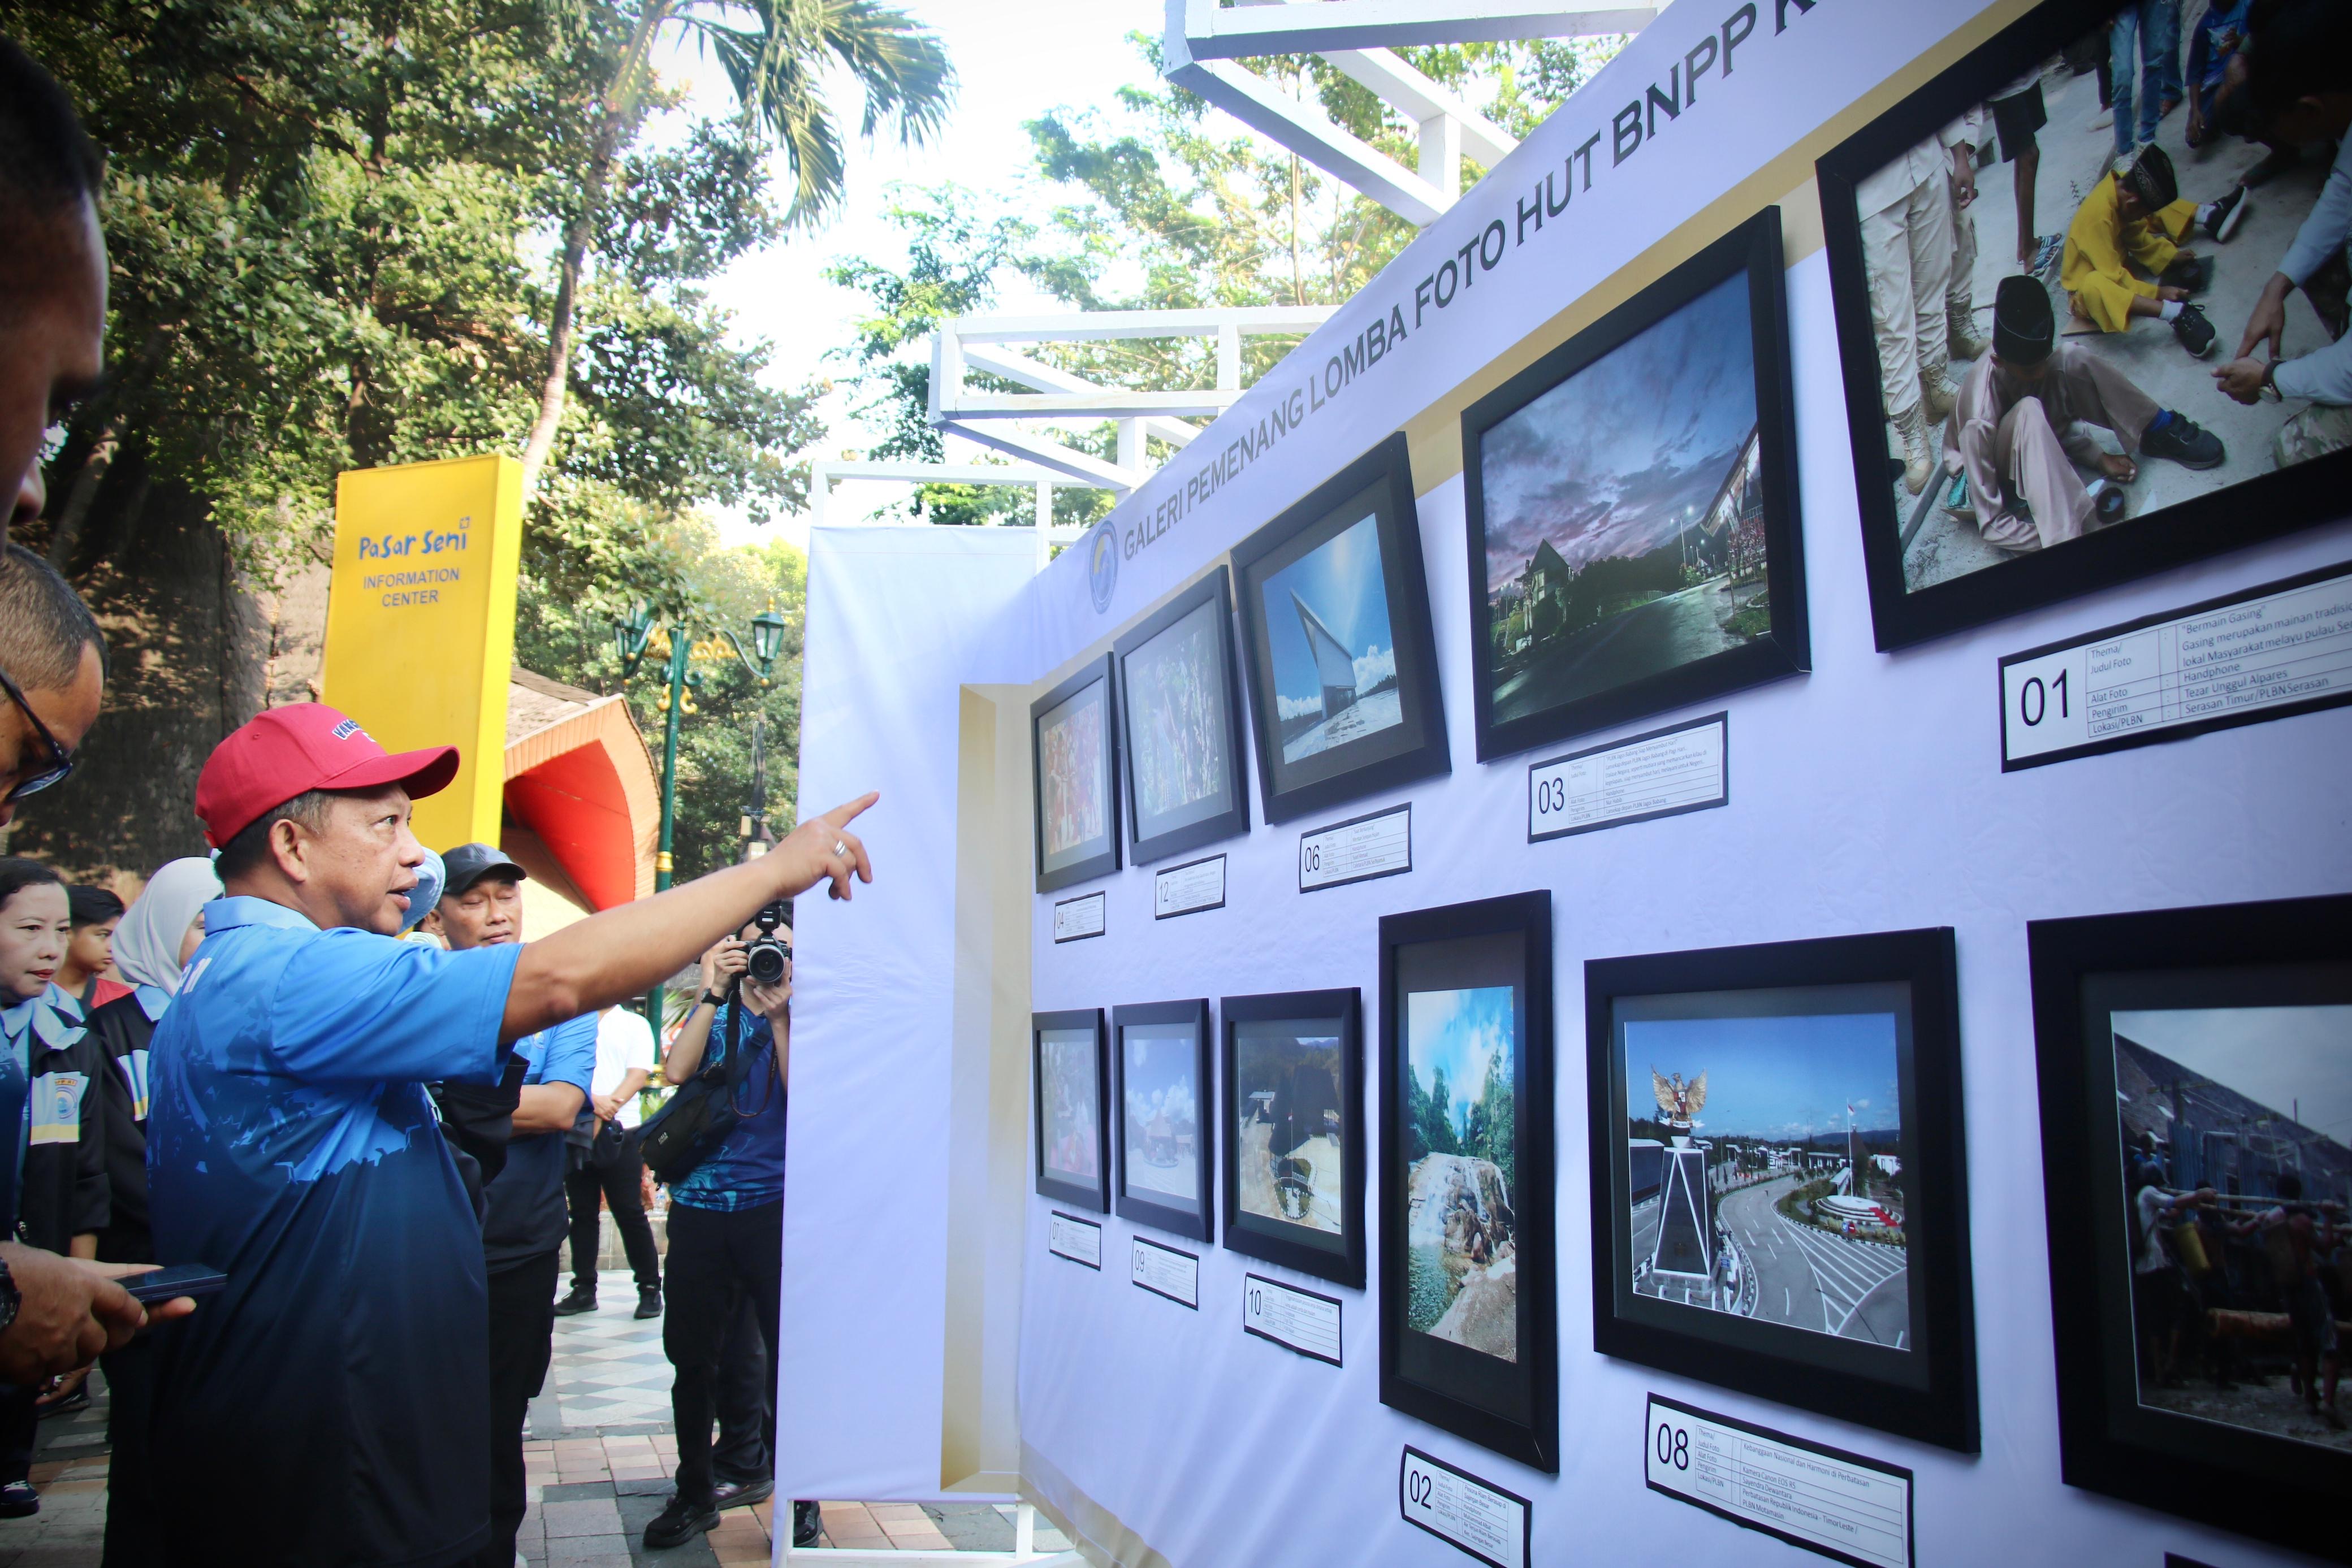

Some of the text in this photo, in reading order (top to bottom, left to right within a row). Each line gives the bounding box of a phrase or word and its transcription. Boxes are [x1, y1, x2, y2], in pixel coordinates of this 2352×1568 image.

[1124, 2, 1757, 561] GALERI PEMENANG LOMBA FOTO HUT BNPP
[421, 530, 466, 554] Seni
[363, 568, 460, 589] INFORMATION
[382, 590, 439, 607] CENTER
[2182, 637, 2214, 651] Gasing
[2216, 622, 2273, 644] merupakan
[2274, 612, 2313, 625] mainan
[2091, 642, 2121, 659] Thema/
[2182, 653, 2205, 668] lokal
[2207, 640, 2264, 662] Masyarakat
[2265, 631, 2303, 648] melayu
[2305, 623, 2334, 640] pulau
[2091, 657, 2132, 674] Judul Foto
[2184, 662, 2241, 683] Handphone
[2185, 669, 2288, 699] Tezar Unggul Alpares
[2021, 668, 2068, 726] 01
[2091, 688, 2128, 703] Alat Foto
[2185, 678, 2329, 714] Serasan Timur/PLBN Serasan
[2092, 703, 2128, 718] Pengirim
[2093, 714, 2143, 733] Lokasi/PLBN
[1538, 777, 1564, 815] 03
[1305, 844, 1320, 872] 06
[1160, 881, 1169, 903] 12
[1057, 911, 1063, 929] 04
[1053, 1222, 1059, 1240] 07
[1135, 1250, 1144, 1272] 09
[1250, 1288, 1261, 1315] 10
[1657, 1423, 1688, 1470] 08
[1697, 1440, 1720, 1452] Judul Foto
[1697, 1450, 1717, 1463] Alat Foto
[1697, 1461, 1717, 1473] Pengirim
[1743, 1466, 1761, 1478] Kamera
[1761, 1471, 1777, 1483] Canon
[1778, 1476, 1788, 1487] EOS
[1744, 1444, 1773, 1457] Kebanggaan
[1774, 1452, 1795, 1465] Nasional
[1796, 1459, 1805, 1469] dan
[1806, 1462, 1830, 1476] Harmoni
[1838, 1471, 1870, 1488] Perbatasan
[1410, 1470, 1432, 1510] 02
[1698, 1472, 1724, 1487] Lokasi/PLBN
[1743, 1476, 1792, 1500] Sayendra Dewantara
[1743, 1499, 1784, 1520] PLBN Motamasin
[1743, 1488, 1770, 1504] Perbatasan
[1770, 1495, 1791, 1511] Republik
[1792, 1504, 1818, 1520] Indonesia
[1822, 1515, 1839, 1527] Timor
[1839, 1522, 1854, 1532] Leste
